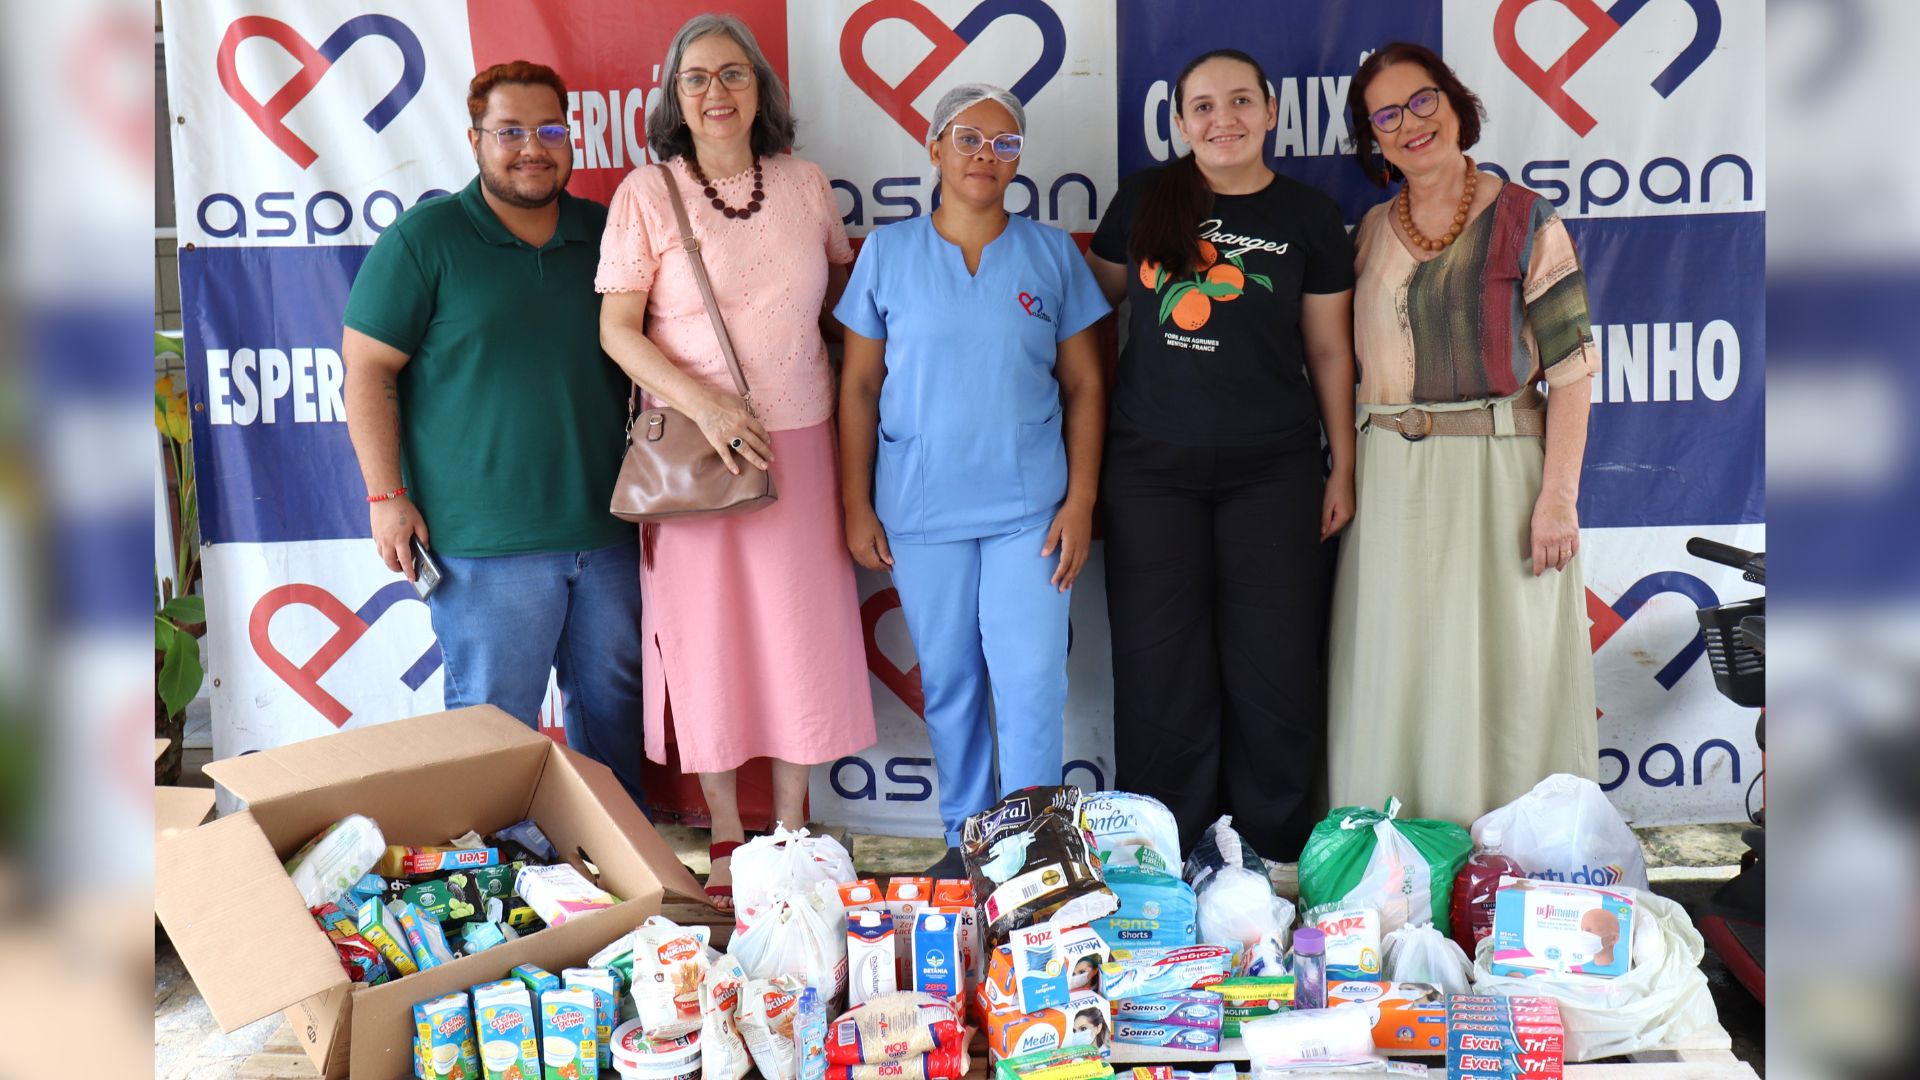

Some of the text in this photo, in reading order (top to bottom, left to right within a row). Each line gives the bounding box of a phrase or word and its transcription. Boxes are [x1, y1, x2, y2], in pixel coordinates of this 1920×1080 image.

[830, 172, 1097, 226] asan
[197, 189, 452, 244] aspa
[1164, 332, 1219, 346] FOIRE AUX AGRUMES
[1167, 339, 1188, 349] MENTON
[1192, 343, 1215, 352] FRANCE
[206, 348, 348, 426] ESPER
[982, 801, 1027, 838] Pral
[459, 851, 489, 864] Even
[1110, 918, 1160, 930] Pants
[1316, 917, 1365, 937] Topz
[1023, 930, 1052, 945] Topz
[1122, 931, 1149, 939] Shorts
[1065, 939, 1101, 954] Medix
[1168, 951, 1216, 962] Colgate
[925, 983, 948, 991] zero
[1341, 985, 1379, 993] Medix
[1122, 1003, 1166, 1011] SORRISO
[490, 1011, 519, 1029] cremo
[498, 1015, 524, 1034] gema
[551, 1011, 580, 1025] cremo
[558, 1015, 584, 1031] gema
[1120, 1027, 1165, 1037] SORRISO
[884, 1041, 908, 1054] BOM
[1023, 1032, 1056, 1049] Medix
[1460, 1034, 1502, 1050] Even
[1524, 1038, 1546, 1052] Tri
[1460, 1055, 1502, 1071] Even
[1523, 1058, 1546, 1072] Tri
[879, 1066, 902, 1076] BOM
